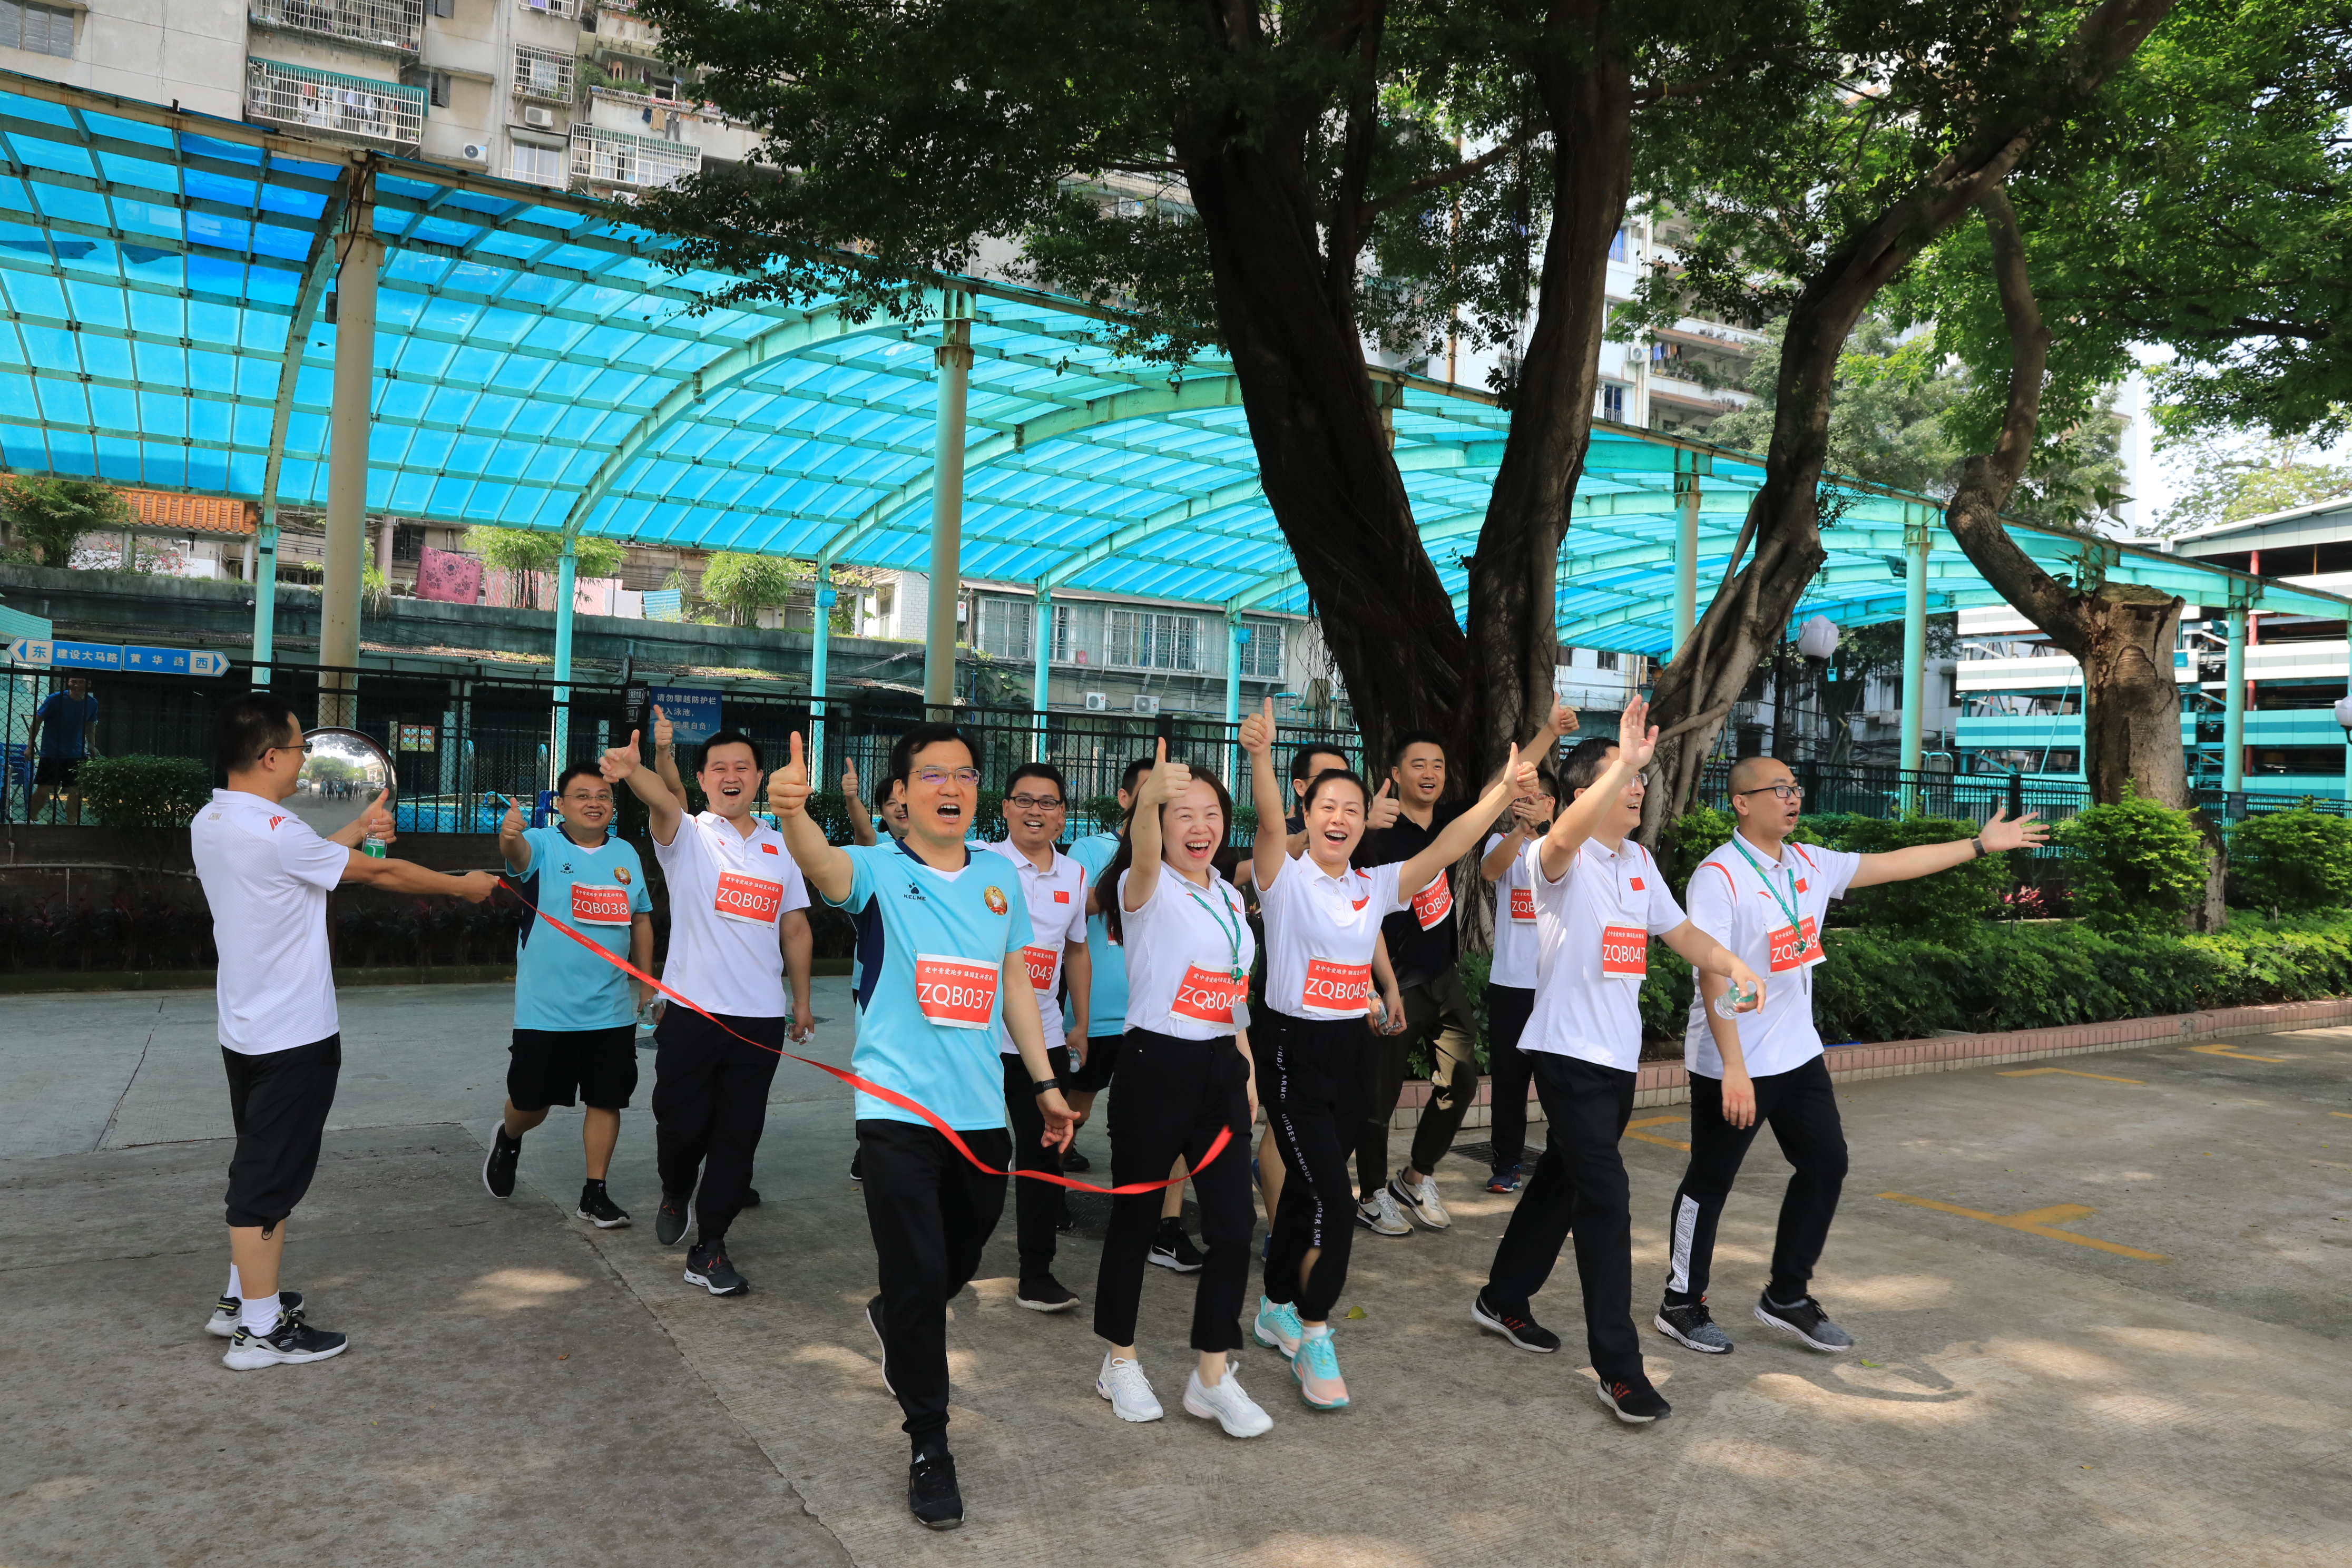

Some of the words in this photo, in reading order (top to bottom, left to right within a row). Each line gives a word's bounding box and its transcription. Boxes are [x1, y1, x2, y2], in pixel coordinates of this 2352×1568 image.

[32, 645, 47, 659] 东
[56, 648, 119, 663] 建设大马路
[130, 653, 185, 667] 黄华路
[195, 656, 208, 669] 西
[656, 693, 717, 705] 请勿攀越防护栏
[575, 889, 598, 897] 爱中青爱跑步
[725, 876, 753, 887] 爱中青爱跑步
[754, 883, 780, 893] 强国复兴有我
[572, 897, 629, 915] ZQB038
[717, 887, 778, 914] ZQB031
[1800, 921, 1812, 930] 复兴有我
[1603, 944, 1646, 964] ZQB047
[925, 966, 963, 977] 爱中青爱跑步
[964, 971, 994, 982] 强国复兴有我
[1315, 964, 1347, 975] 爱中青爱跑步
[918, 982, 995, 1011] ZQB037
[1305, 977, 1368, 1001] ZQB045
